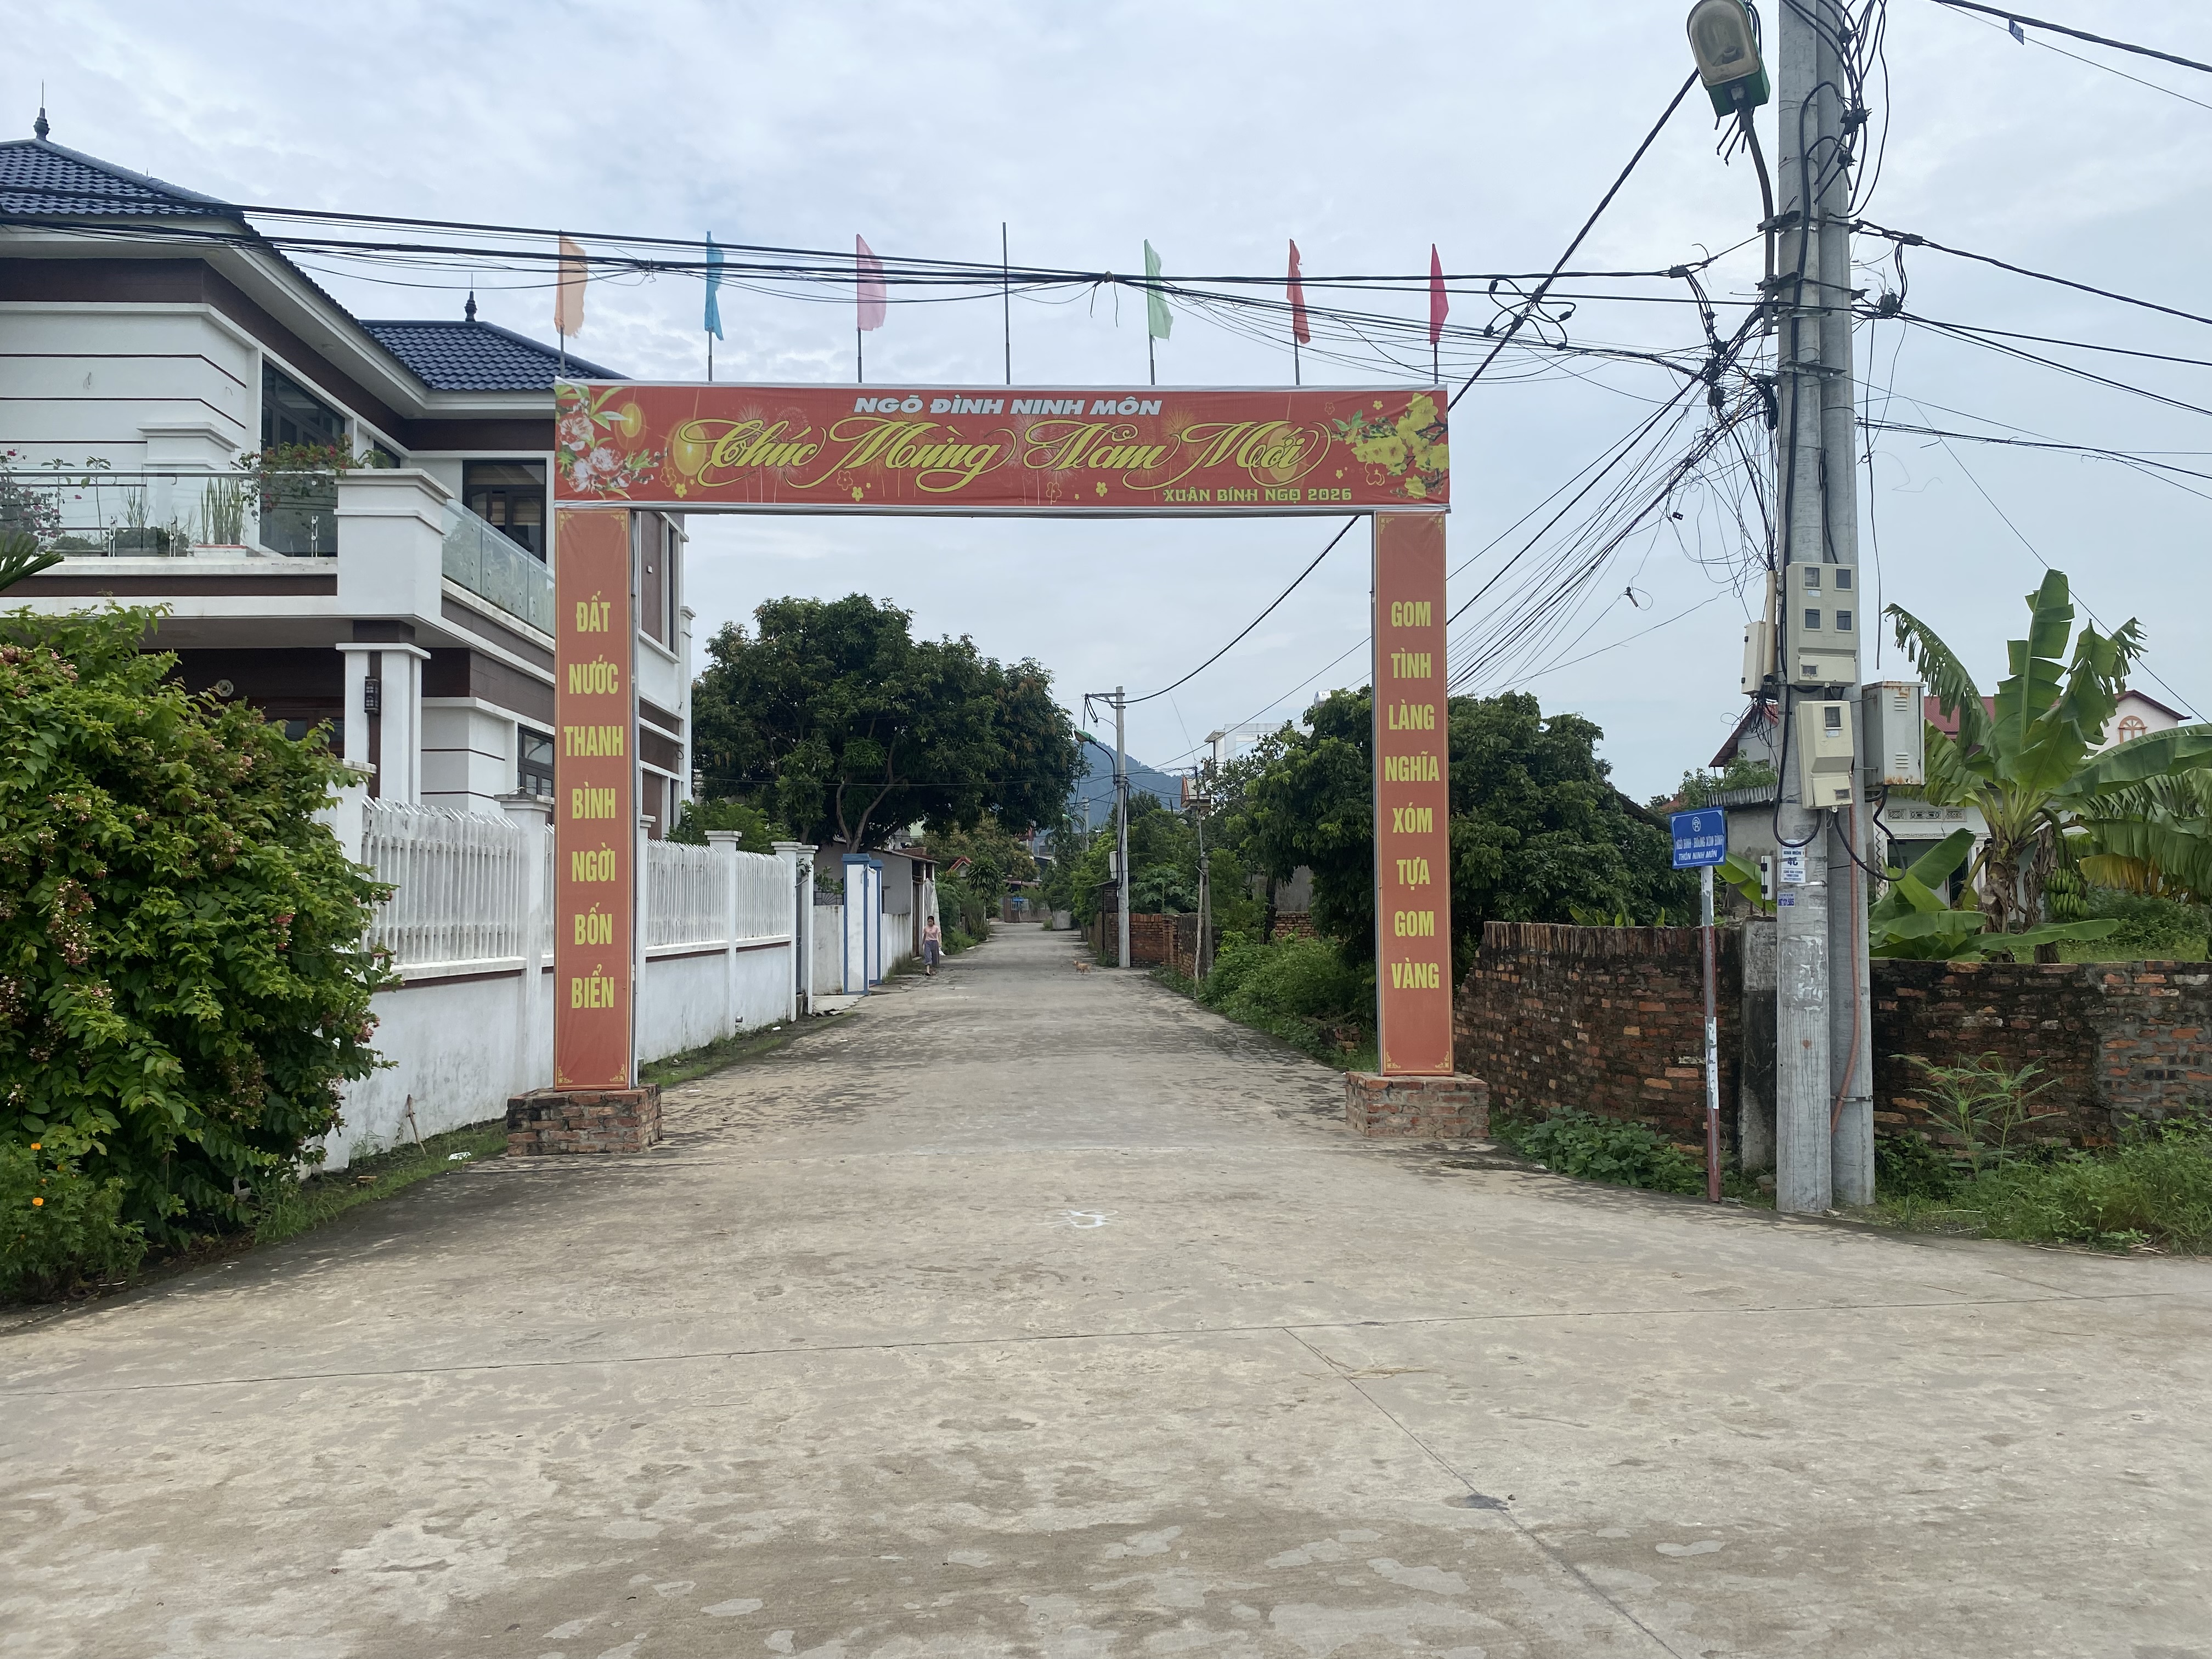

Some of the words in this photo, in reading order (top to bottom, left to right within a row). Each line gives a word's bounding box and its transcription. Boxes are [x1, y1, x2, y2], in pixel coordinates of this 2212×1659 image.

[854, 394, 923, 413] NGÕ
[930, 394, 1004, 414] ĐÌNH
[1010, 399, 1085, 415] NINH
[1090, 396, 1162, 415] MÔN
[679, 418, 827, 488] Chúc
[783, 416, 1017, 493] Mừng
[1122, 420, 1331, 490] Mới
[1163, 486, 1211, 502] XUÂN
[1217, 486, 1258, 502] BÍNH
[1265, 488, 1301, 504] NGỌ
[1308, 488, 1352, 501] 2026
[576, 590, 611, 633] ĐẤT
[1391, 601, 1431, 627] GOM
[569, 654, 618, 695] NƯỚC
[1391, 647, 1431, 679] TÌNH
[1389, 699, 1435, 730] LÀNG
[564, 726, 624, 757] THANH
[1385, 751, 1440, 782] NGHĨA
[572, 781, 616, 819] BÌNH
[1392, 802, 1432, 833] XÓM
[572, 842, 616, 882] NGỜI
[1692, 851, 1705, 860] NINH
[1396, 856, 1431, 890] TỰA
[574, 902, 612, 945] BỐN
[1394, 911, 1434, 936] GOM
[572, 963, 614, 1009] BIỂN
[1391, 957, 1440, 989] VÀNG
